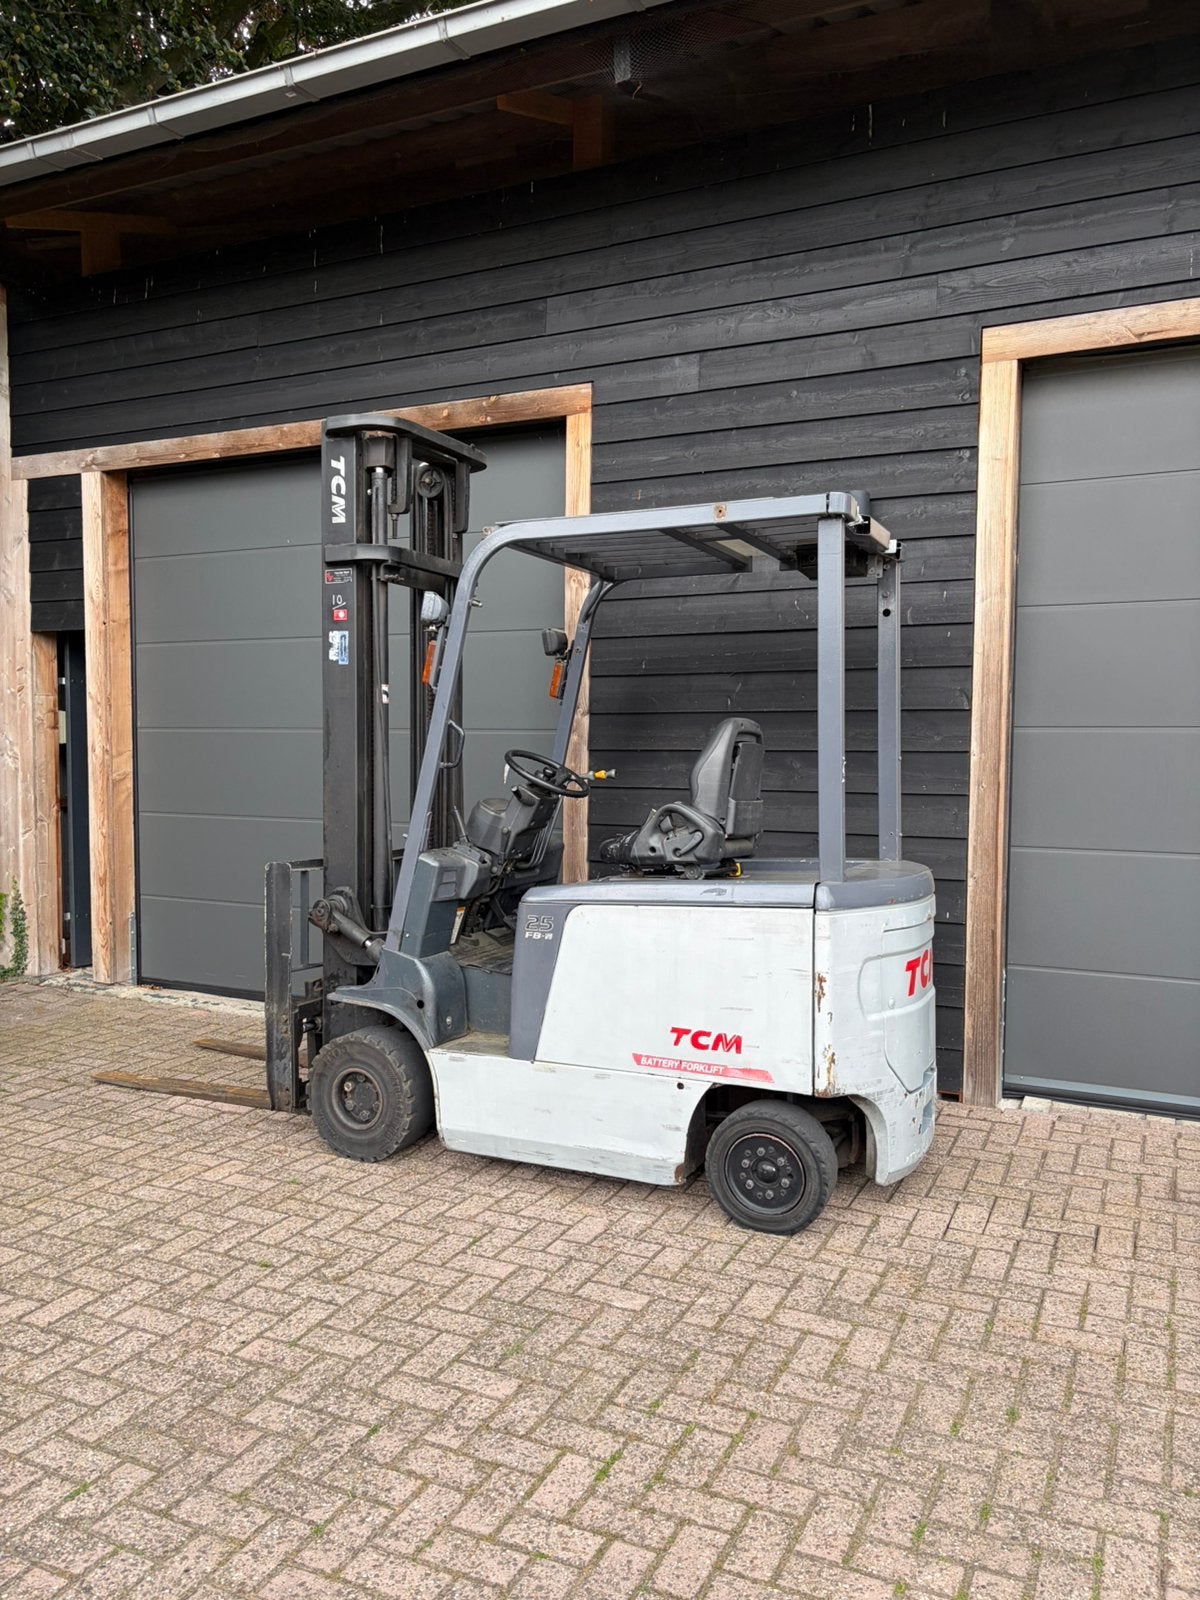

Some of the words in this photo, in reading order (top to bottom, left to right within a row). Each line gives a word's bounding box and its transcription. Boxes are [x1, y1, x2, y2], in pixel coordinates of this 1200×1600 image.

[331, 455, 346, 524] TCM
[525, 914, 554, 932] 25
[905, 948, 932, 997] TC
[670, 1026, 742, 1054] TCM
[640, 1056, 680, 1069] BATTERY
[680, 1061, 724, 1074] FORKLIFT
